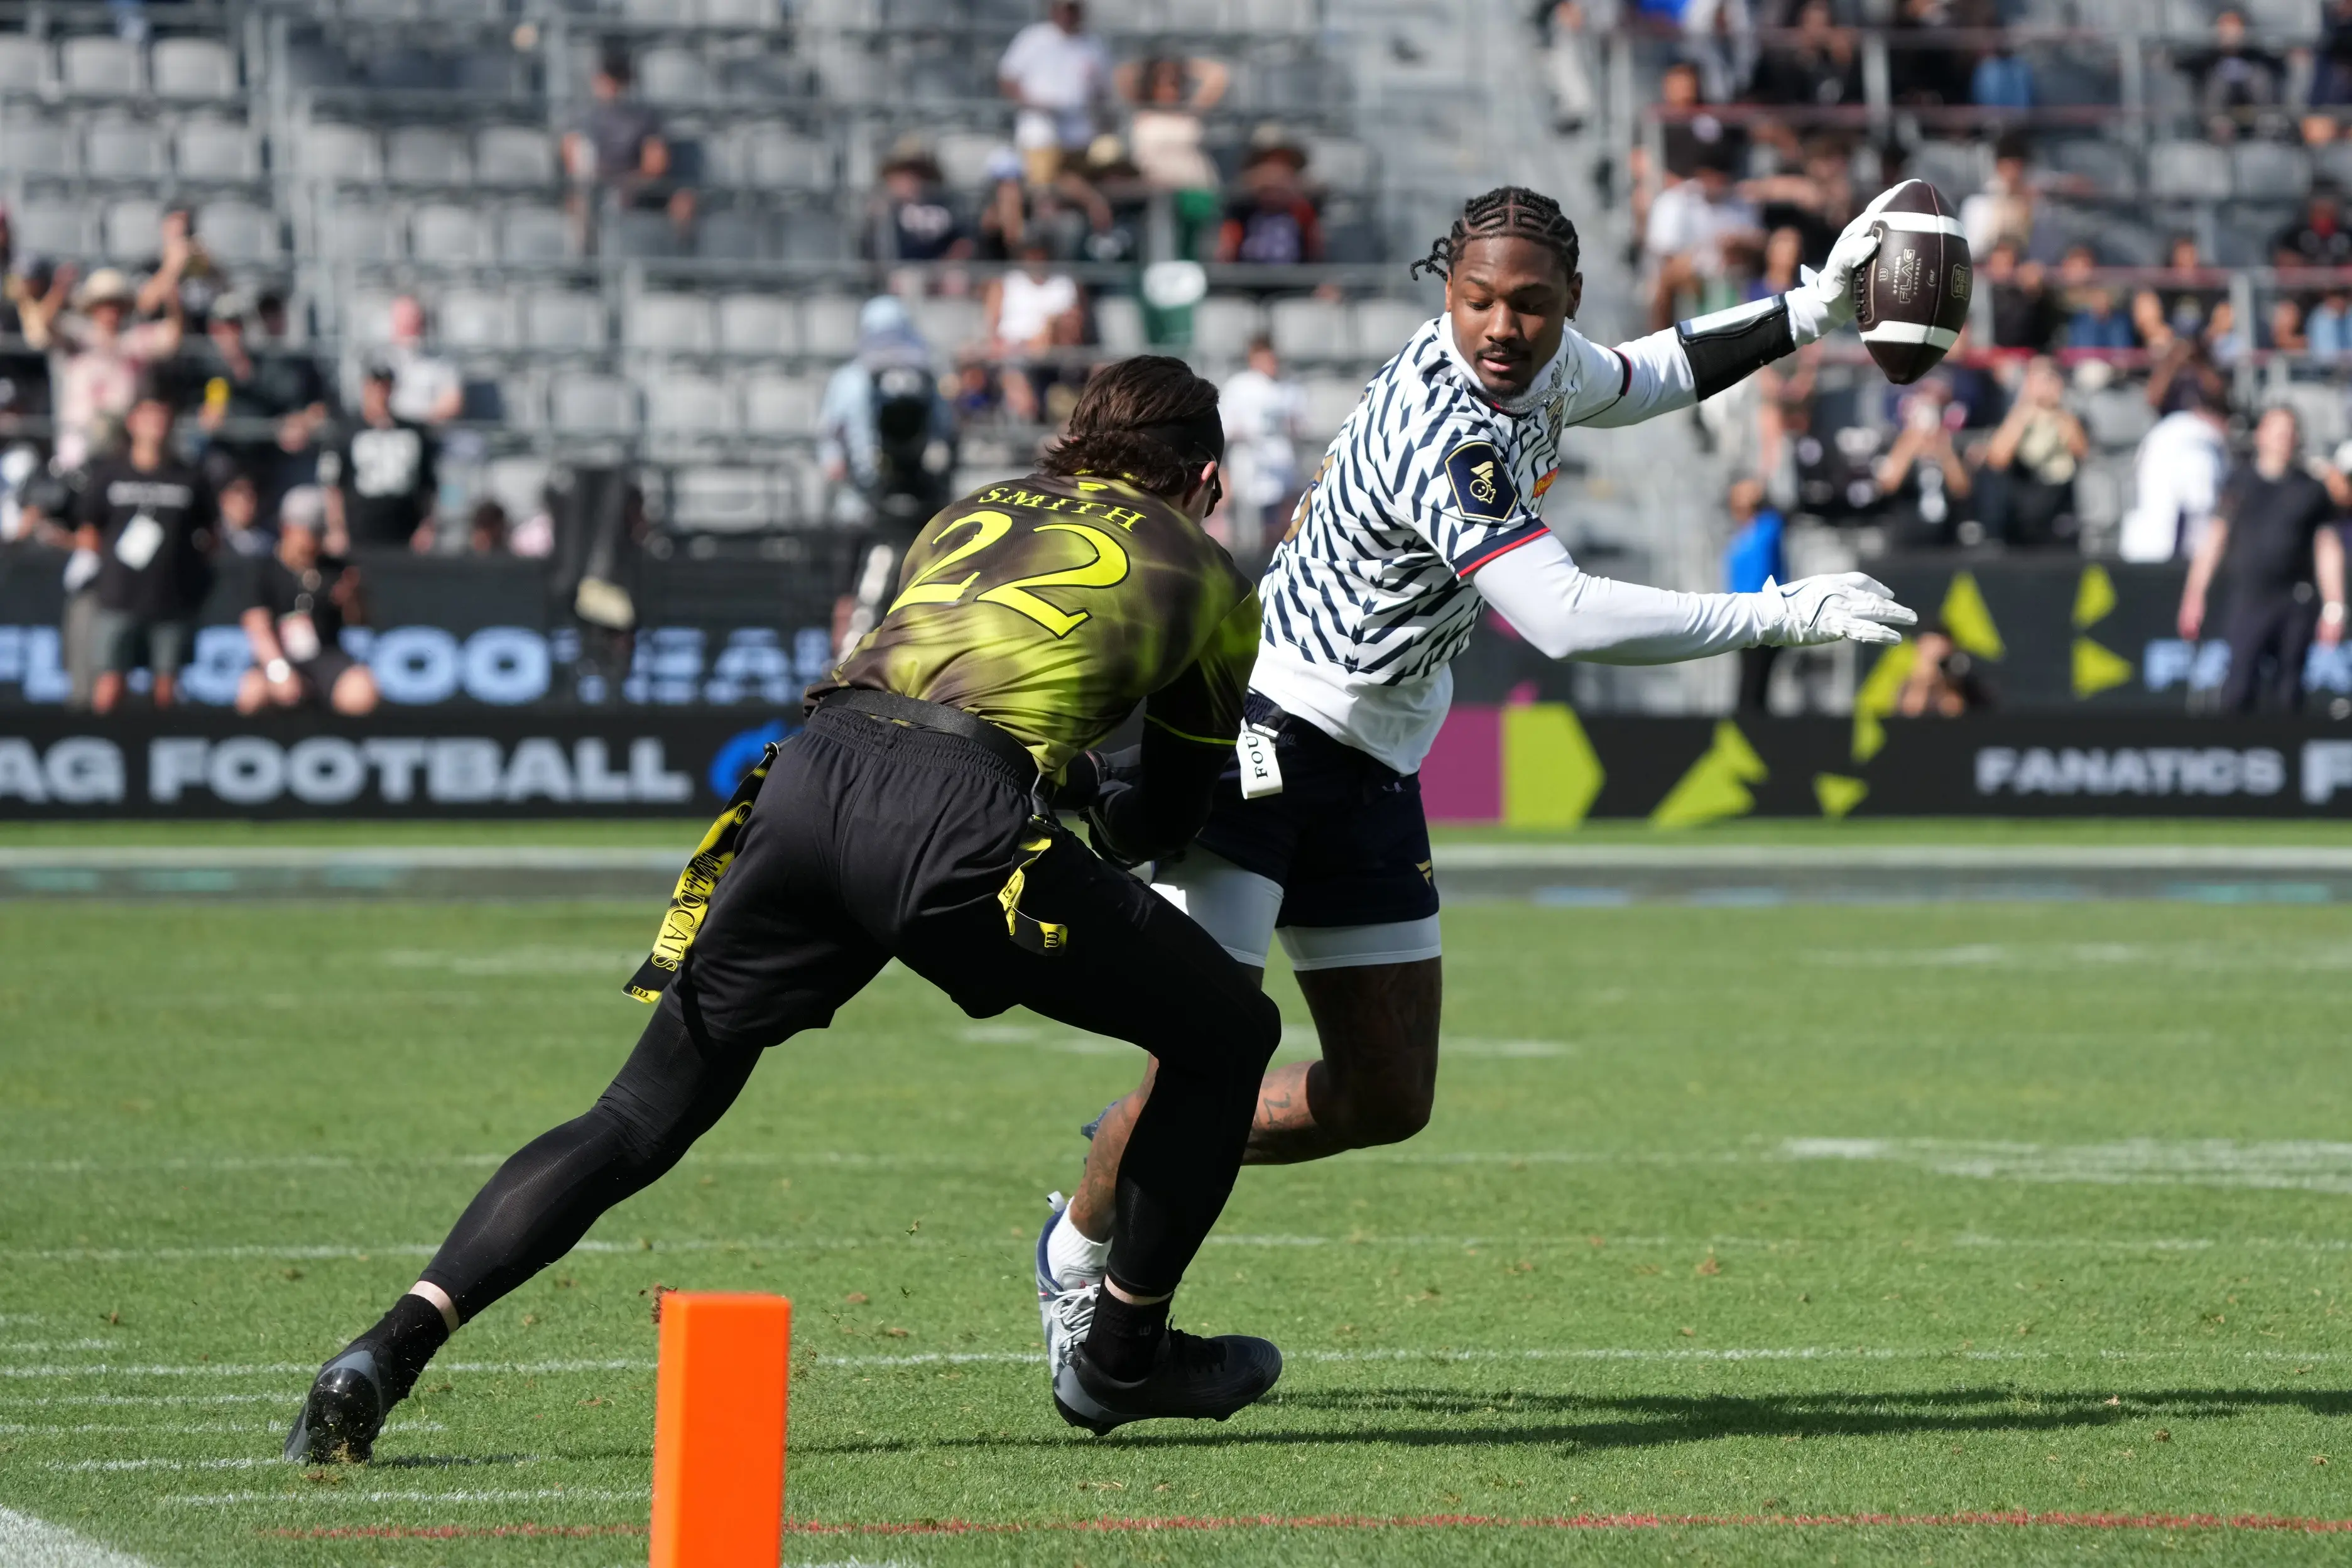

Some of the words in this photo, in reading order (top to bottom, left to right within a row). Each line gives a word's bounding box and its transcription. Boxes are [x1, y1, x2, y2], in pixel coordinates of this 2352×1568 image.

[1899, 248, 1915, 304] FLAG
[977, 487, 1147, 533] SMITH
[886, 510, 1131, 640] 22
[148, 734, 694, 805] FOOTBALL
[1244, 735, 1268, 780] FOU
[1974, 747, 2285, 795] FANATICS
[651, 851, 724, 972] WILDCATS
